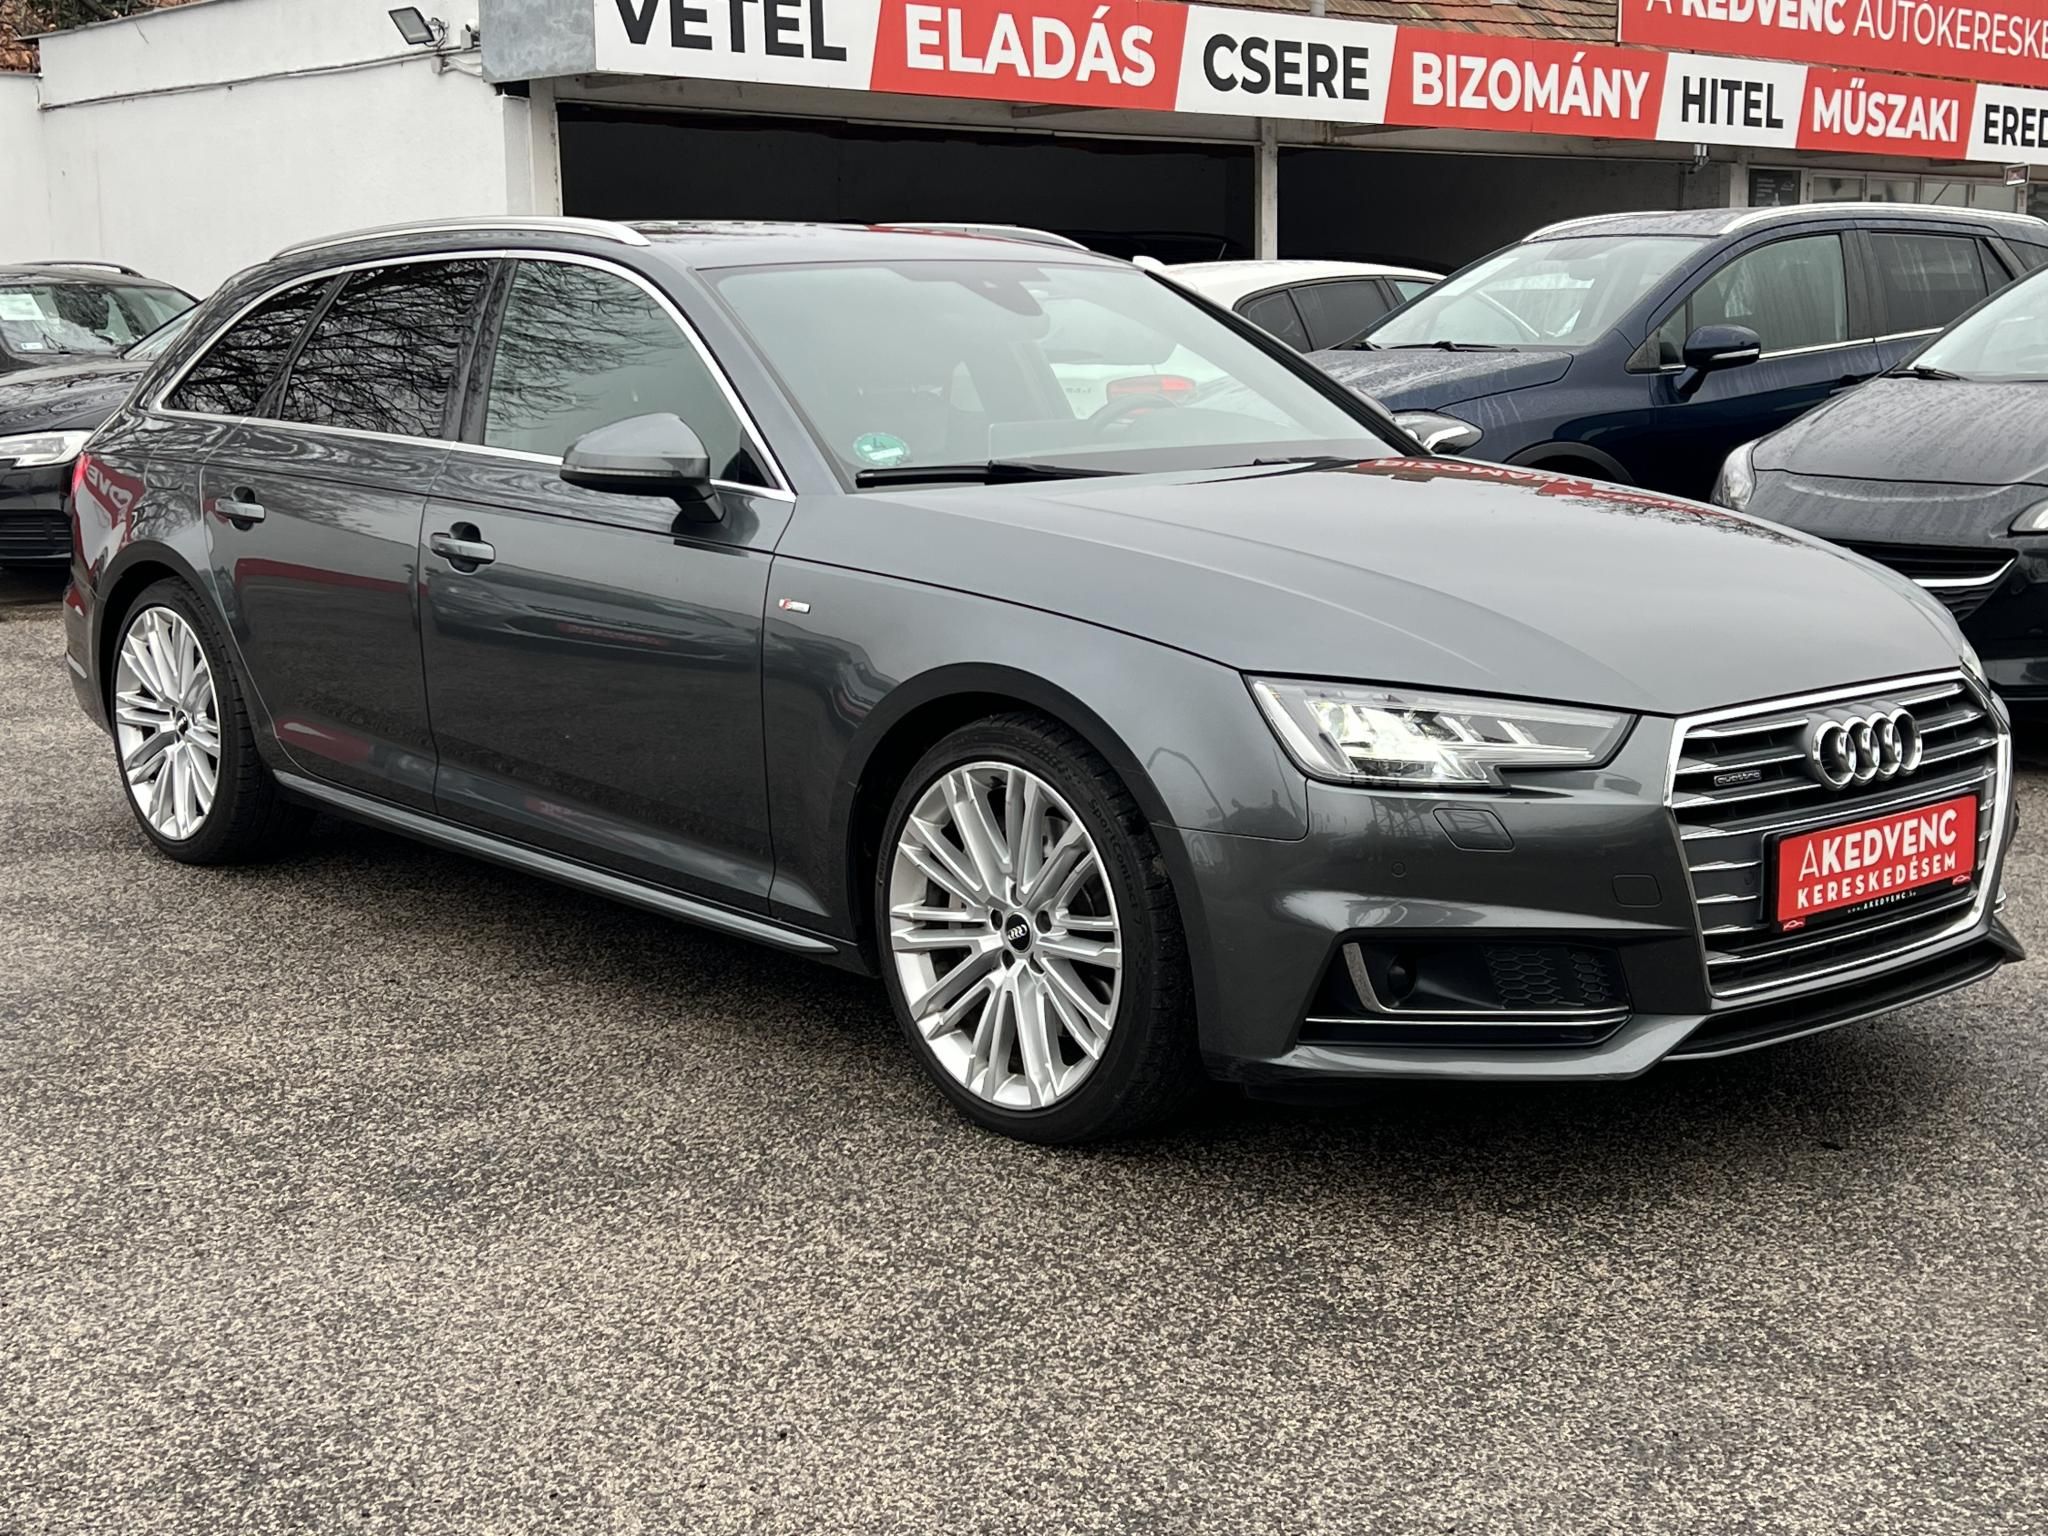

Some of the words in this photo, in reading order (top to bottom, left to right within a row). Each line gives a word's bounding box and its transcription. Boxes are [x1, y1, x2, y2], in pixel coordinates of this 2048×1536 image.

[905, 4, 1156, 87] ELADÁS
[1203, 33, 1369, 101] CSERE
[1412, 51, 1650, 120] BIZOMÁNY
[1682, 75, 1784, 129] HITEL
[1813, 77, 1959, 143] MŰSZAKI
[1797, 848, 1957, 909] KERESKEDÉSEM
